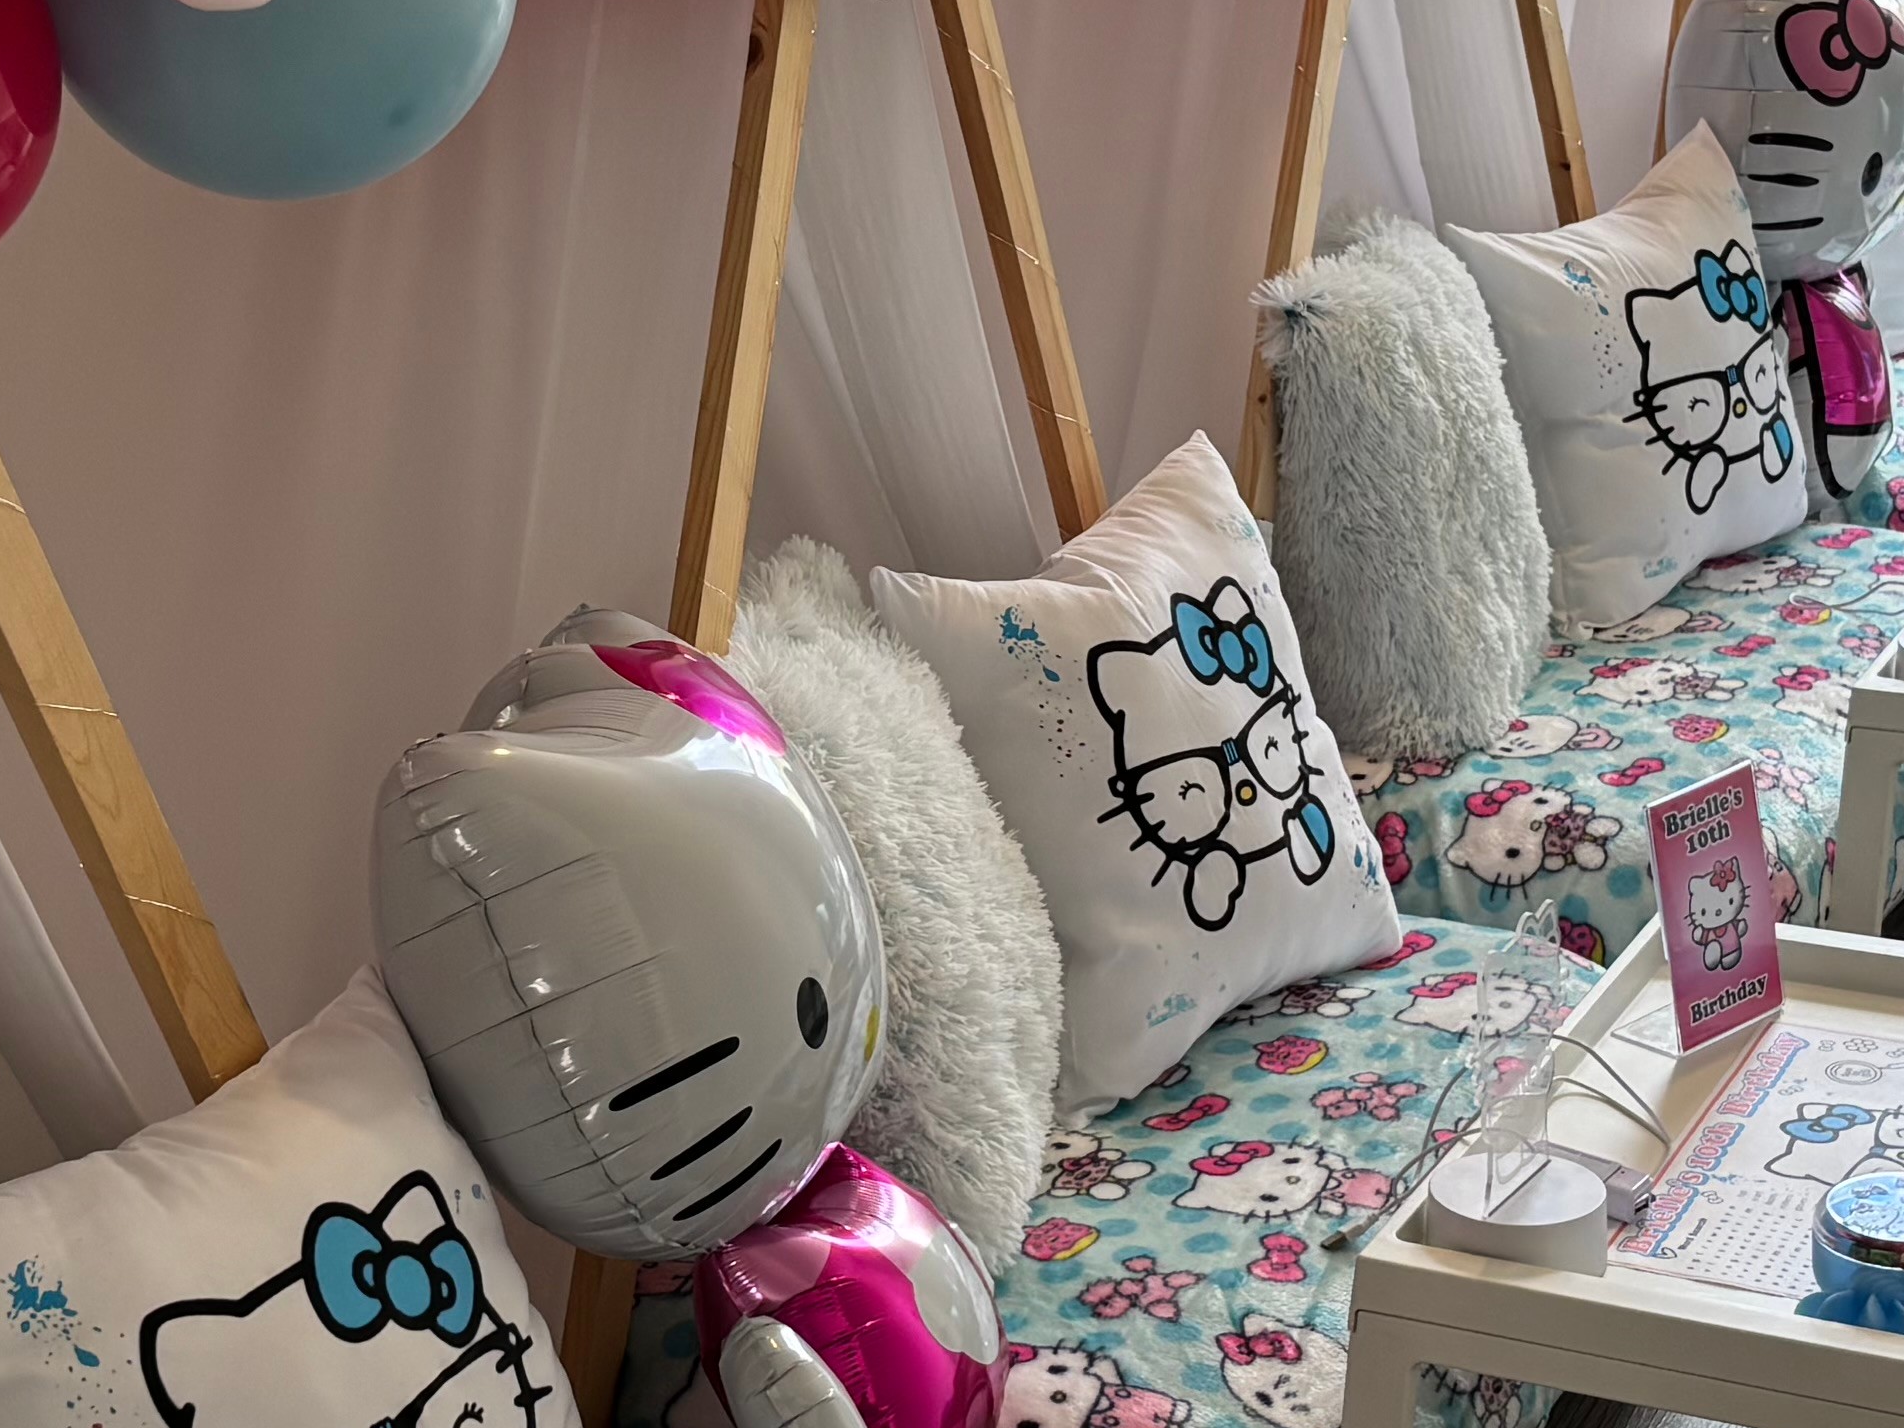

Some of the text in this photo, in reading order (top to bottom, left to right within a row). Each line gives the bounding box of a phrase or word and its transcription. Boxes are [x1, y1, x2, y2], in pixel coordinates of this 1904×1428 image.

[1663, 787, 1743, 837] Brielle's
[1687, 820, 1730, 854] 10th
[1691, 974, 1767, 1024] Birthday
